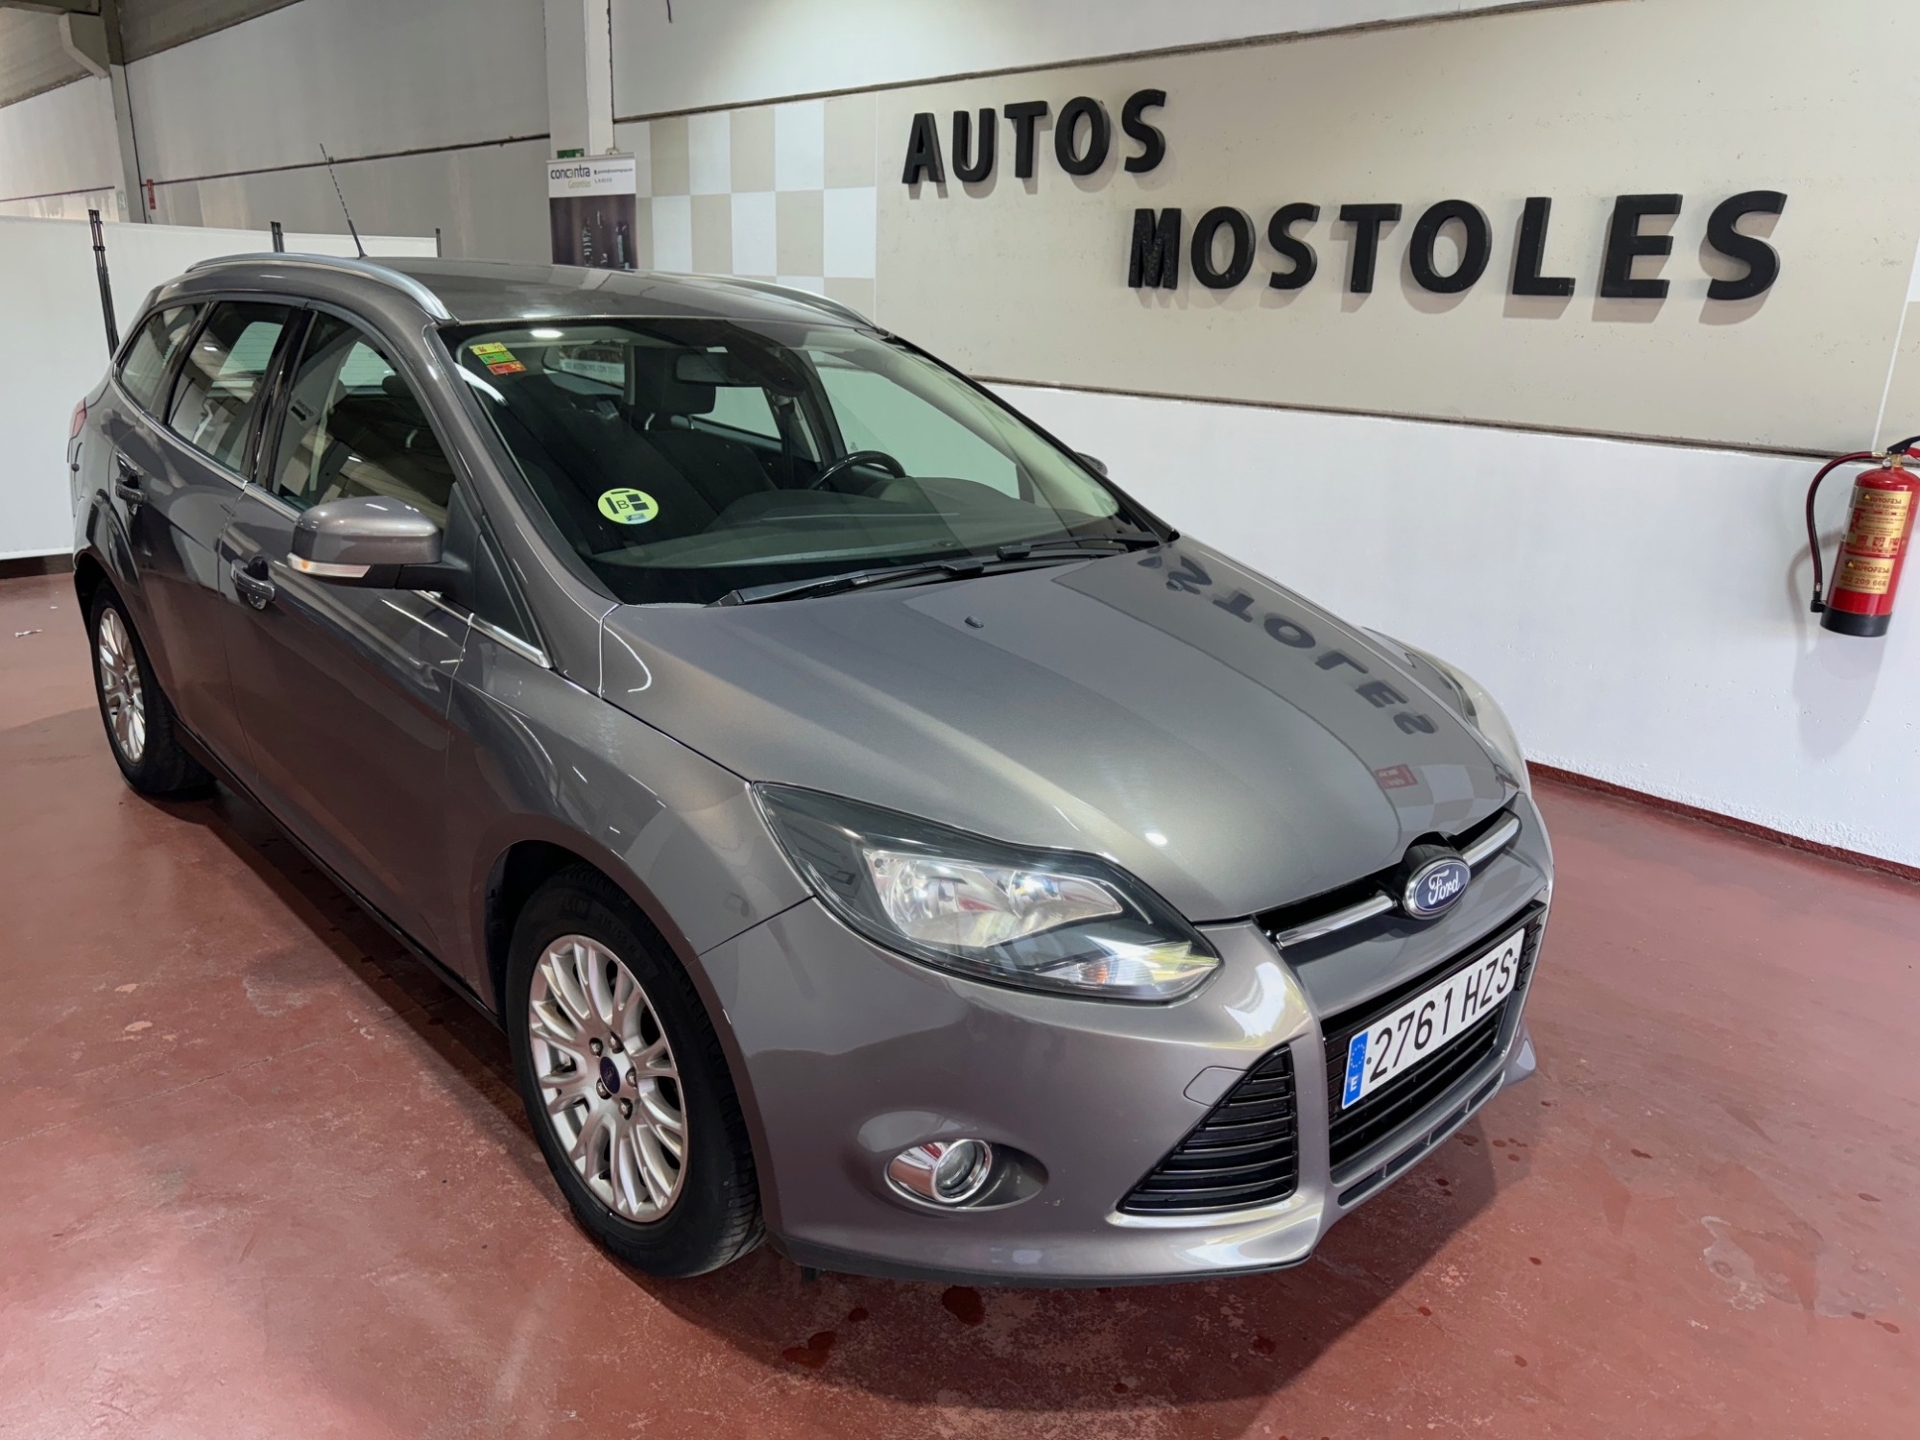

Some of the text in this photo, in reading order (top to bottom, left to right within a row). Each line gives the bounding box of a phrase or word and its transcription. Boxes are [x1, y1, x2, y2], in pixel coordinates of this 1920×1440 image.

[902, 89, 1167, 185] AUTOS
[1128, 190, 1788, 300] MOSTOLES
[616, 500, 630, 510] B
[1855, 577, 1871, 586] 209
[1428, 869, 1461, 906] Ford
[1350, 947, 1514, 1092] E 2761 HZS
